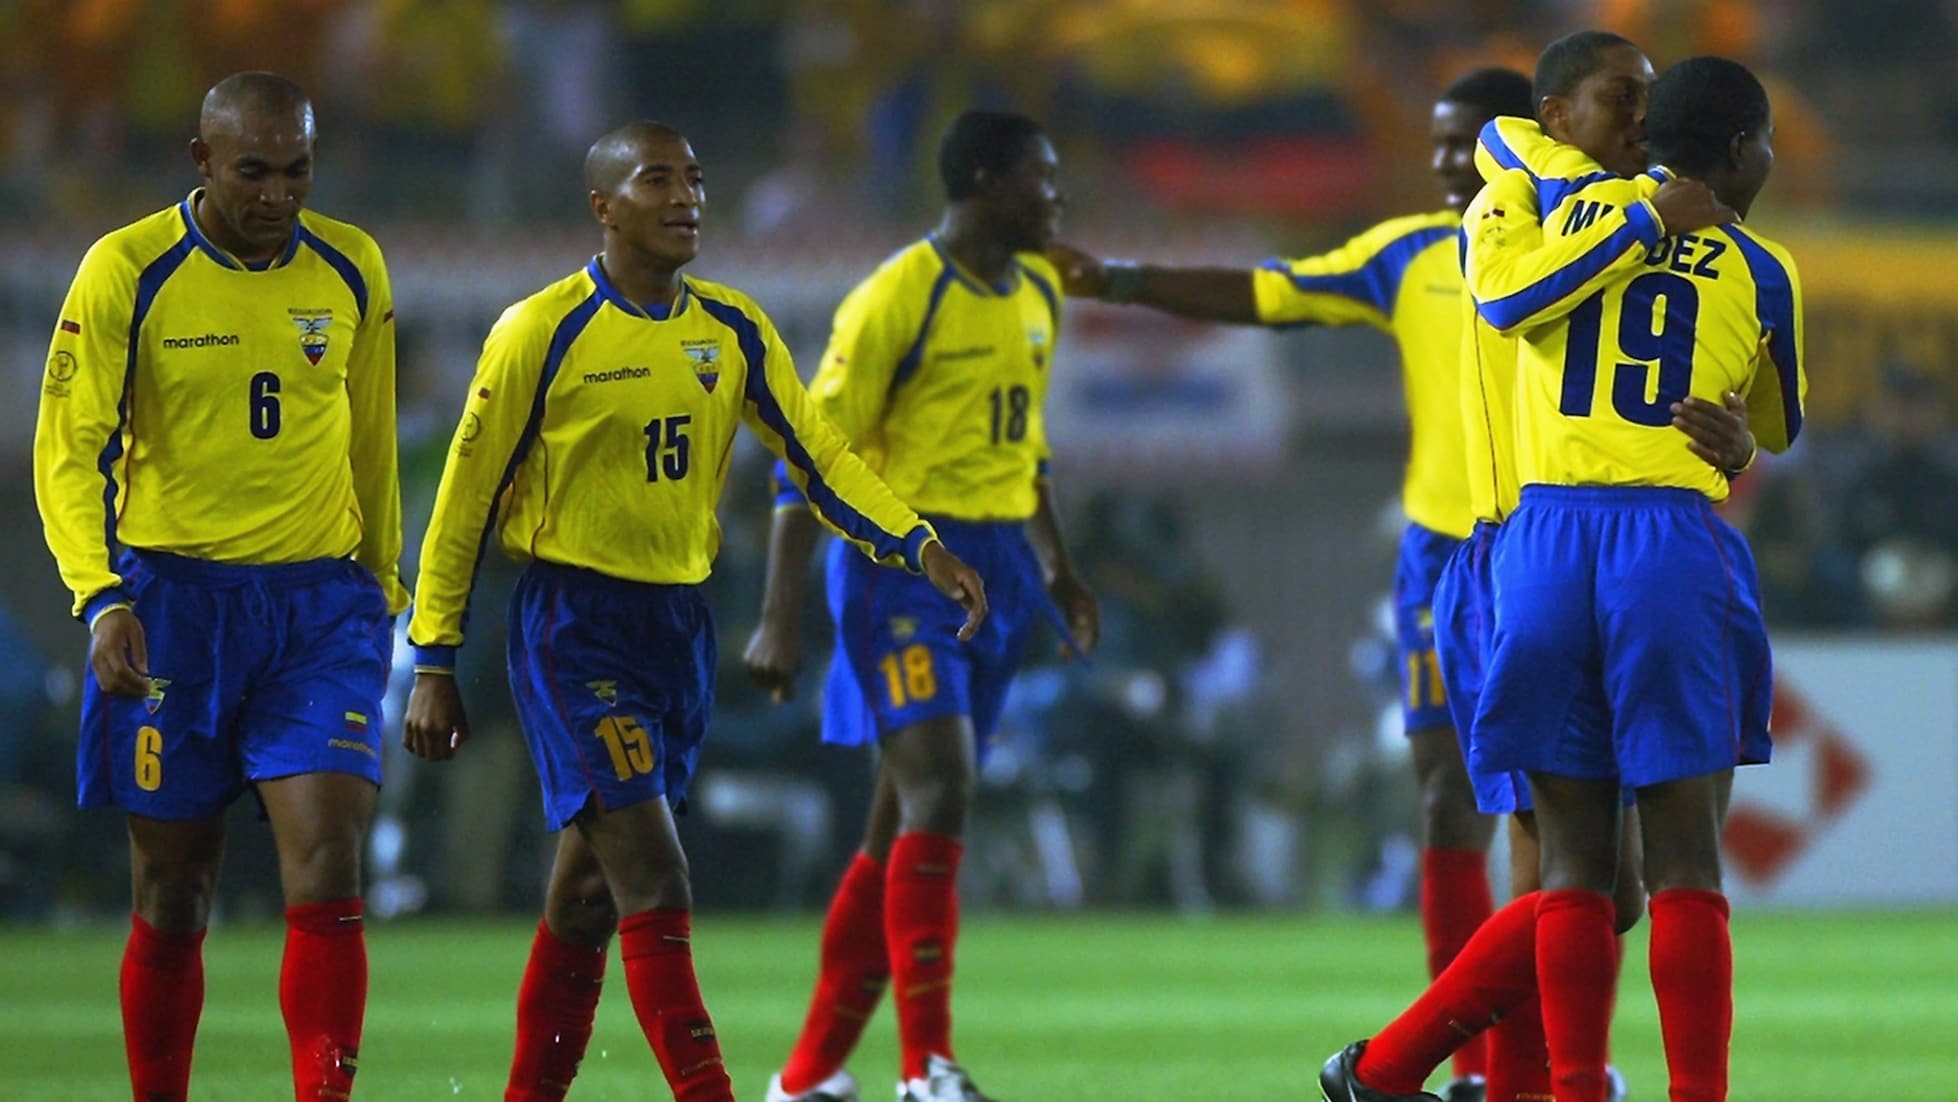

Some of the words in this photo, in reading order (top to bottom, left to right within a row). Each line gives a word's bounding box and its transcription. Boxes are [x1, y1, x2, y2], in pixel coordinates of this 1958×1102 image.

[1561, 199, 1726, 279] MDEZ
[163, 334, 239, 349] marathon
[1560, 272, 1699, 427] 19
[250, 372, 281, 440] 6
[583, 366, 650, 384] marathon
[990, 385, 1029, 445] 18
[643, 415, 692, 482] 15
[880, 645, 936, 707] 18
[135, 726, 163, 791] 6
[595, 715, 654, 781] 15
